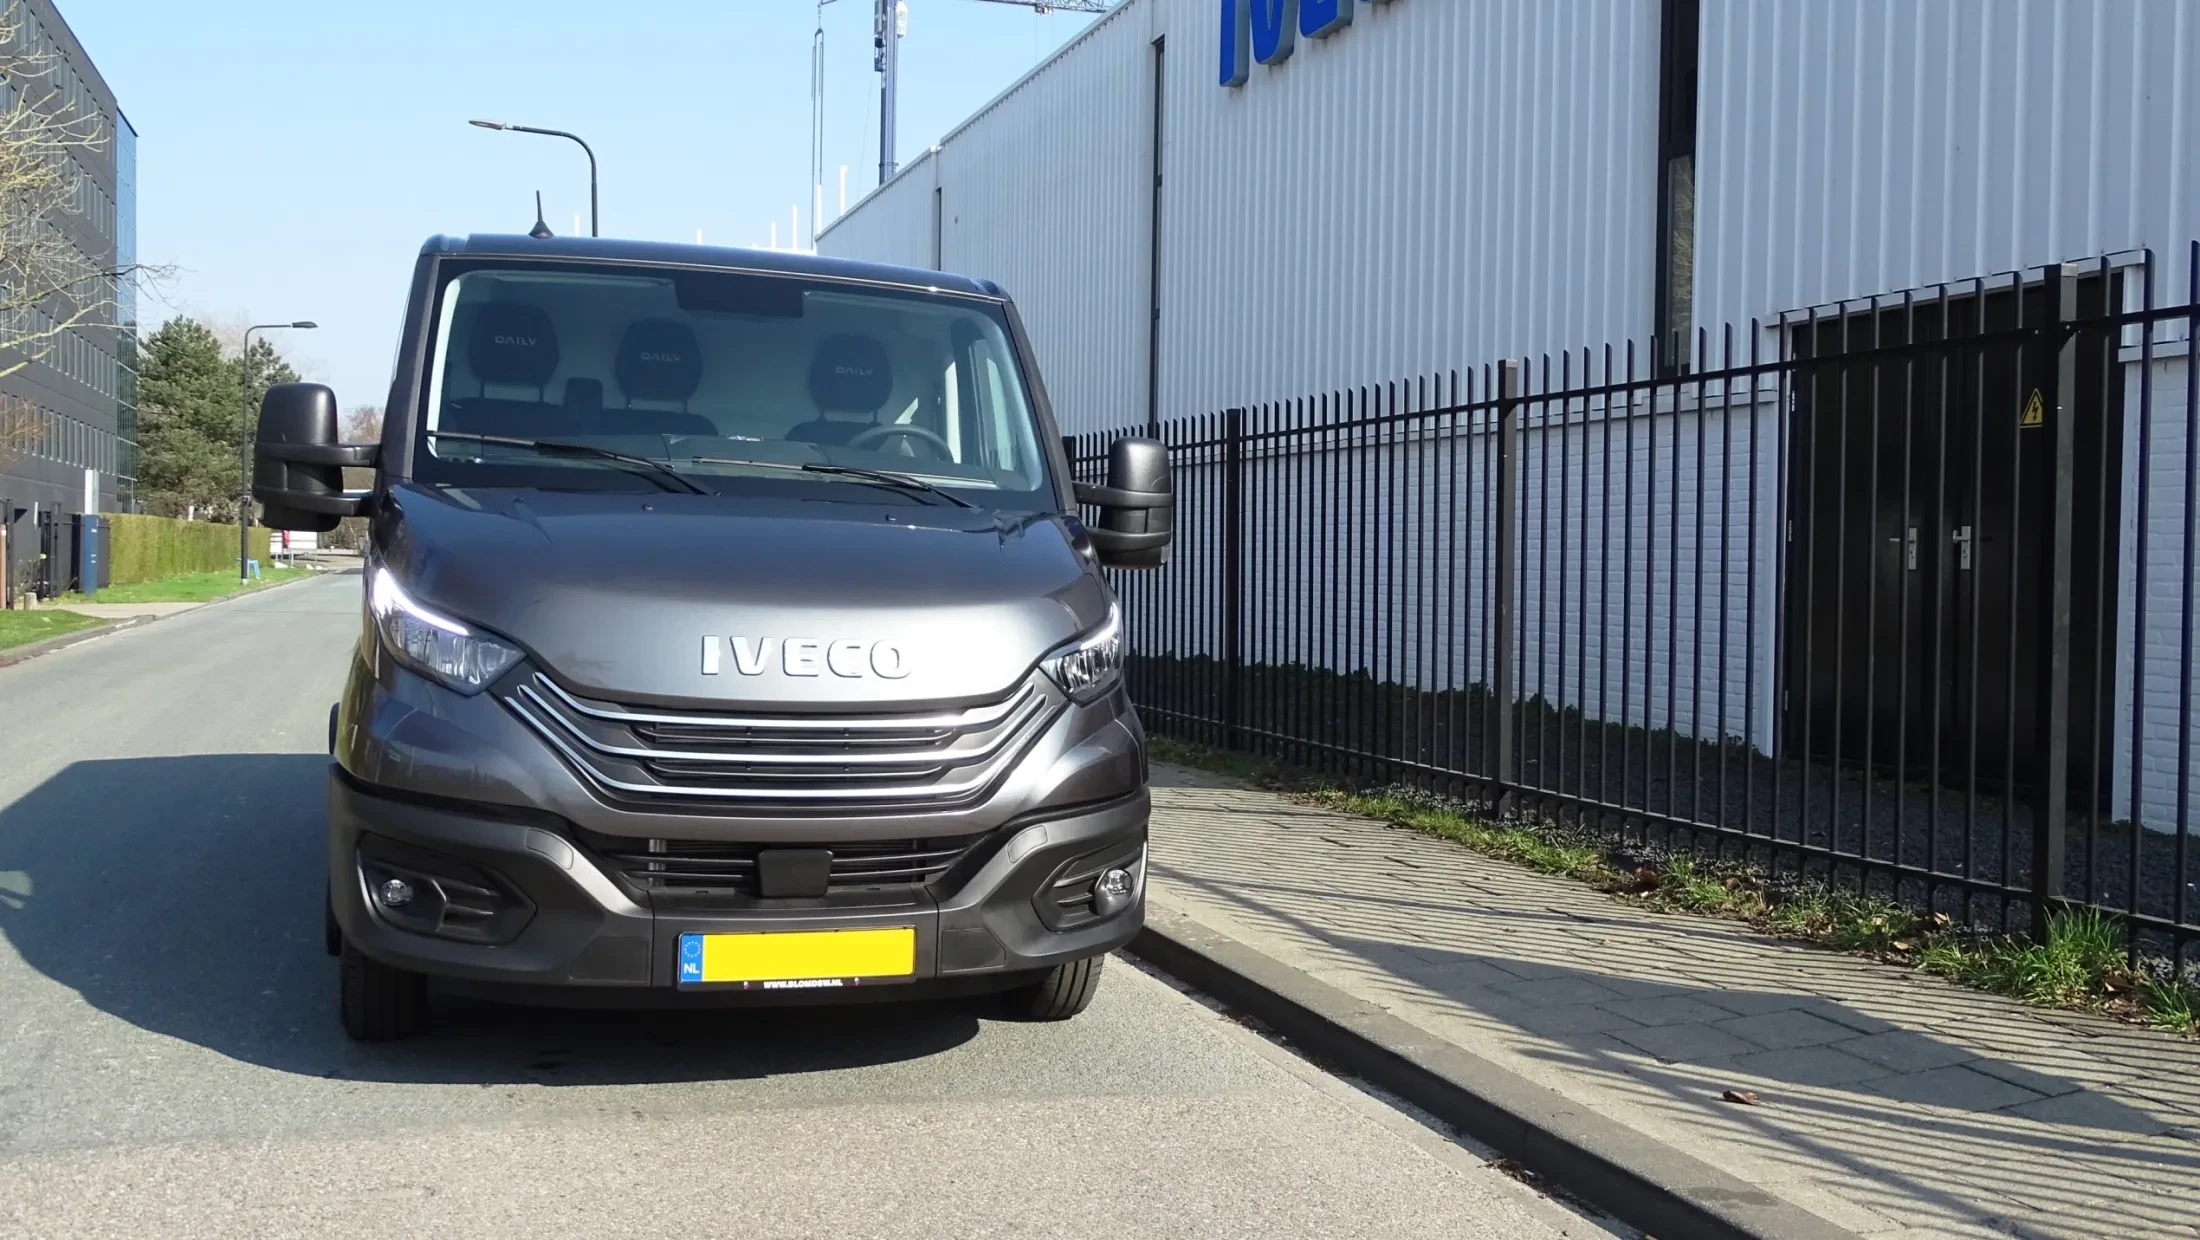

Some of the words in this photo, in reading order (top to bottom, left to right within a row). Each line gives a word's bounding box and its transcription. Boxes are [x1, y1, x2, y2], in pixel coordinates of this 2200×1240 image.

[494, 335, 537, 346] DAILY
[640, 351, 680, 362] DAILY
[835, 365, 873, 376] DAILY
[701, 635, 912, 680] IVECO
[684, 963, 700, 974] NL
